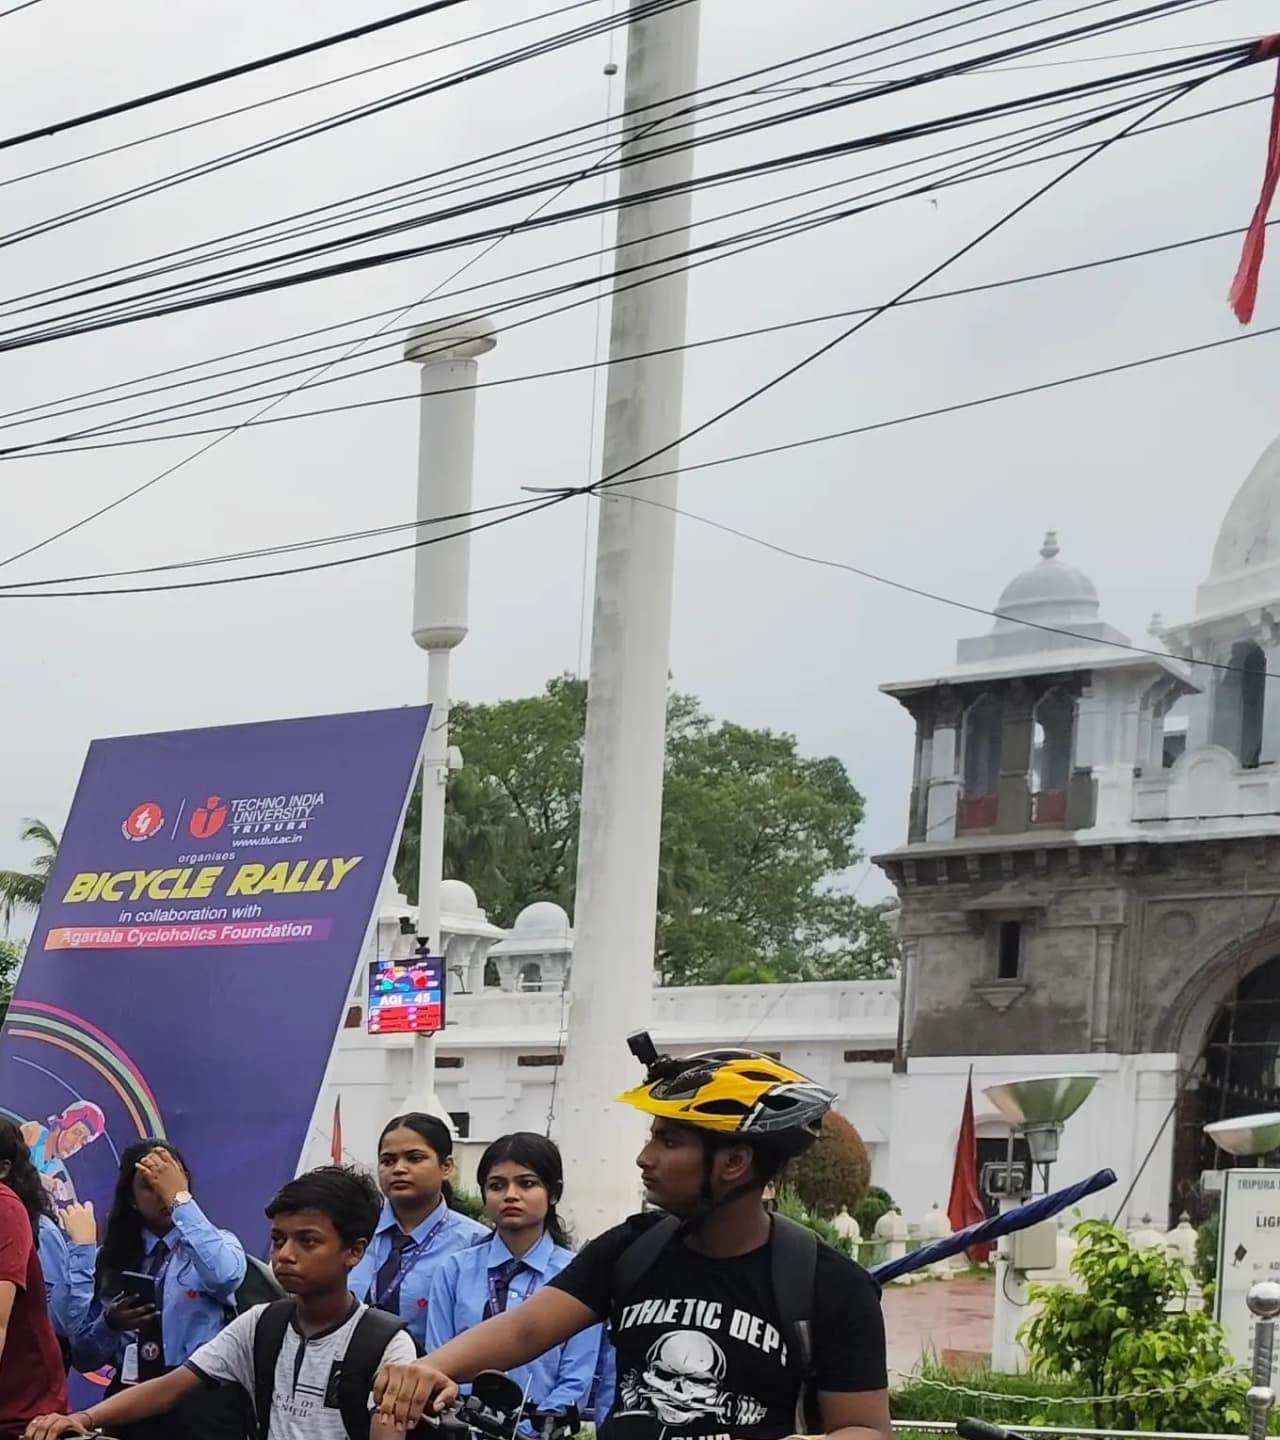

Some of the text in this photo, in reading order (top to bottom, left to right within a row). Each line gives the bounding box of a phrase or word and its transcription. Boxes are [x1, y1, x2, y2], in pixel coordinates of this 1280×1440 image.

[231, 792, 325, 812] TECHNO INDIA
[233, 807, 313, 823] UNIVERSITY
[232, 822, 308, 835] TRIPURA
[178, 852, 236, 864] organises
[62, 856, 364, 903] BICYCLE RALLY
[118, 904, 262, 923] in collaboration with
[60, 922, 312, 945] Agartala Cycloholics Foundation
[1238, 1179, 1275, 1190] TRIPURA
